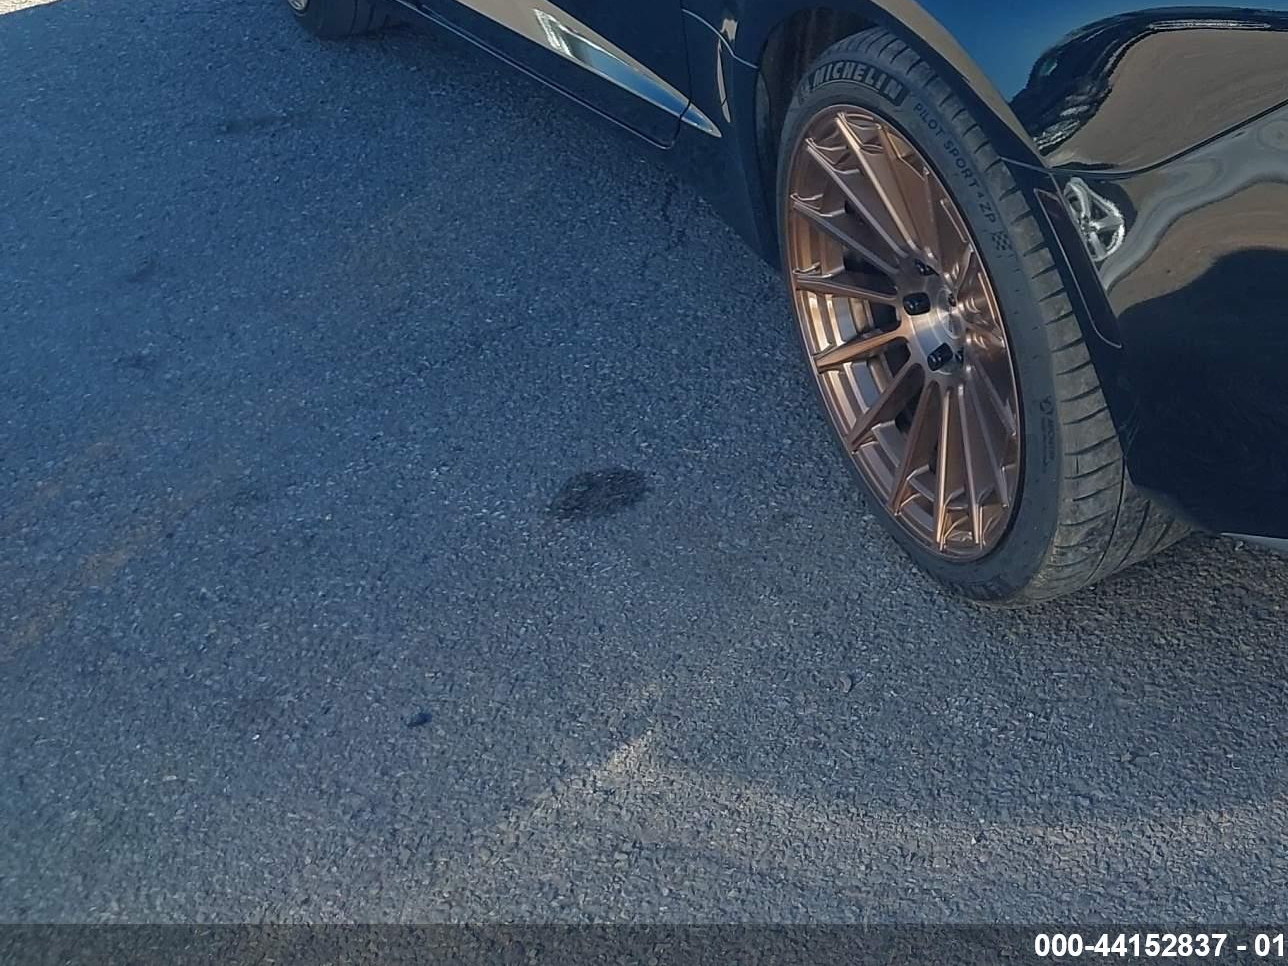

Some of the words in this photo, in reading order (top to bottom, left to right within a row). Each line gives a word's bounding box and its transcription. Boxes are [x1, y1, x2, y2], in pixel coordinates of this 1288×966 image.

[812, 60, 904, 101] MICHELIN
[913, 101, 947, 137] PILOT
[943, 139, 980, 188] SPORT
[979, 200, 997, 224] ZP
